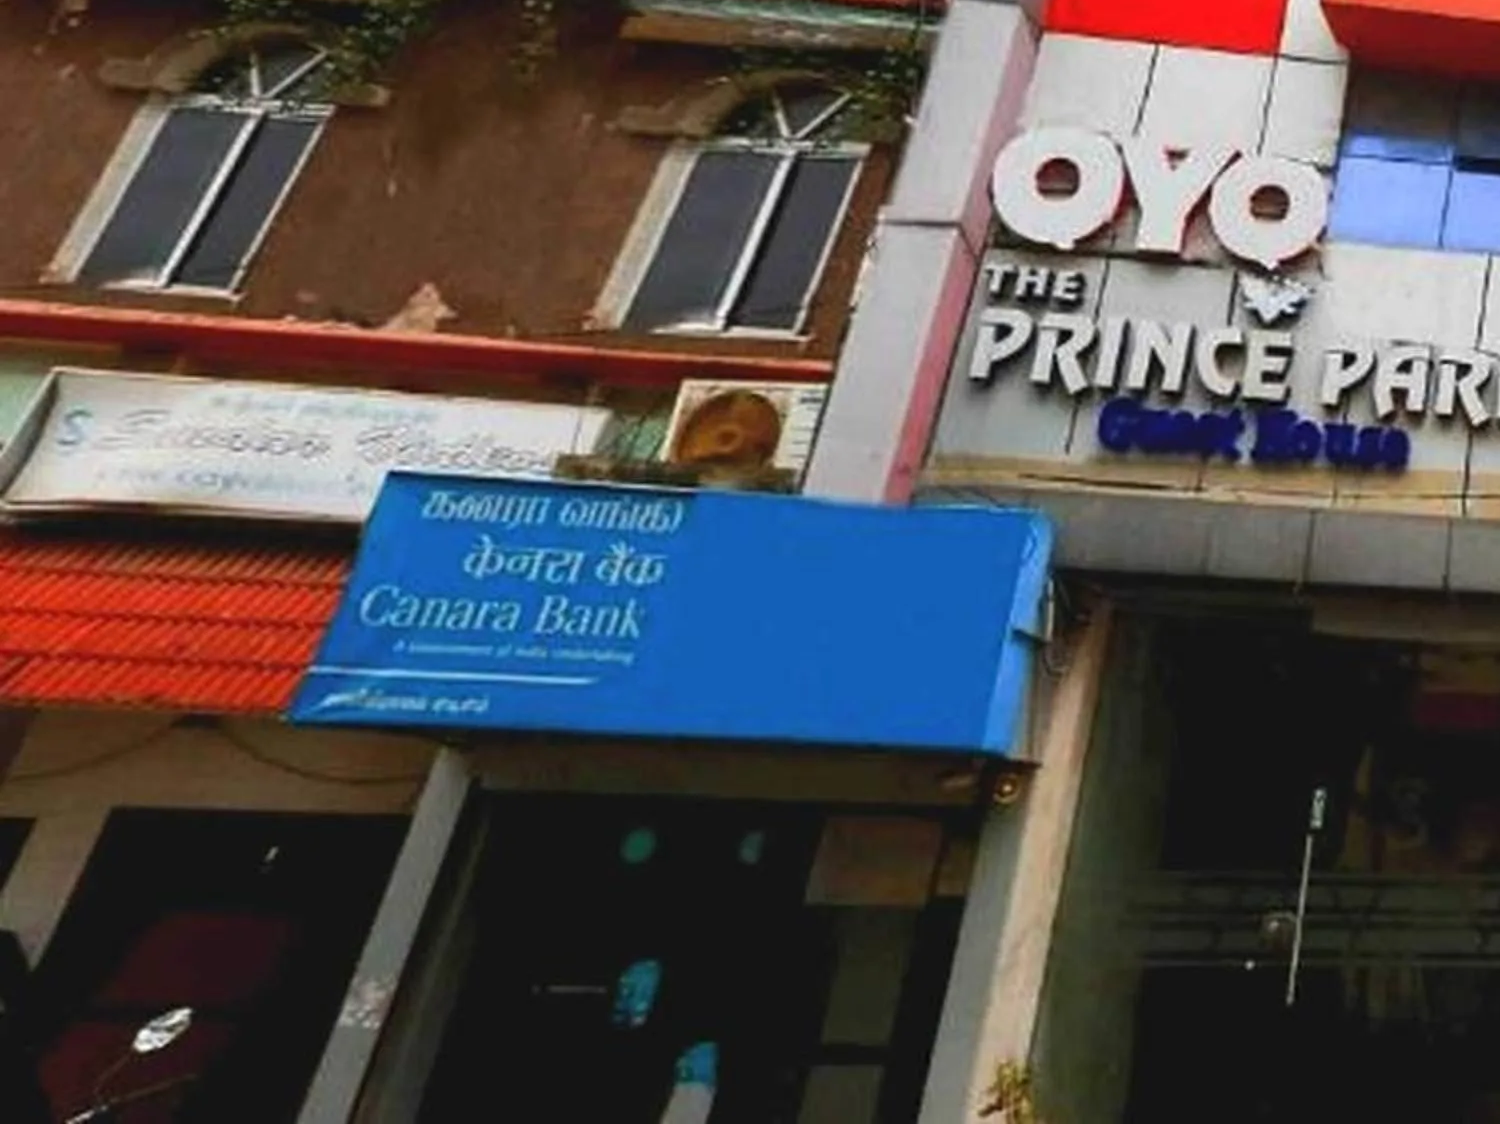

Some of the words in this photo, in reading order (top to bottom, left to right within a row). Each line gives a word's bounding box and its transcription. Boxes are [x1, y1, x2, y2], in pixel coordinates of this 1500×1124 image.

[991, 126, 1329, 271] OYO
[985, 264, 1087, 305] THE
[968, 308, 1296, 403] PRINCE
[462, 533, 586, 586] केनरा
[359, 584, 522, 631] Canara
[534, 594, 641, 640] Bank
